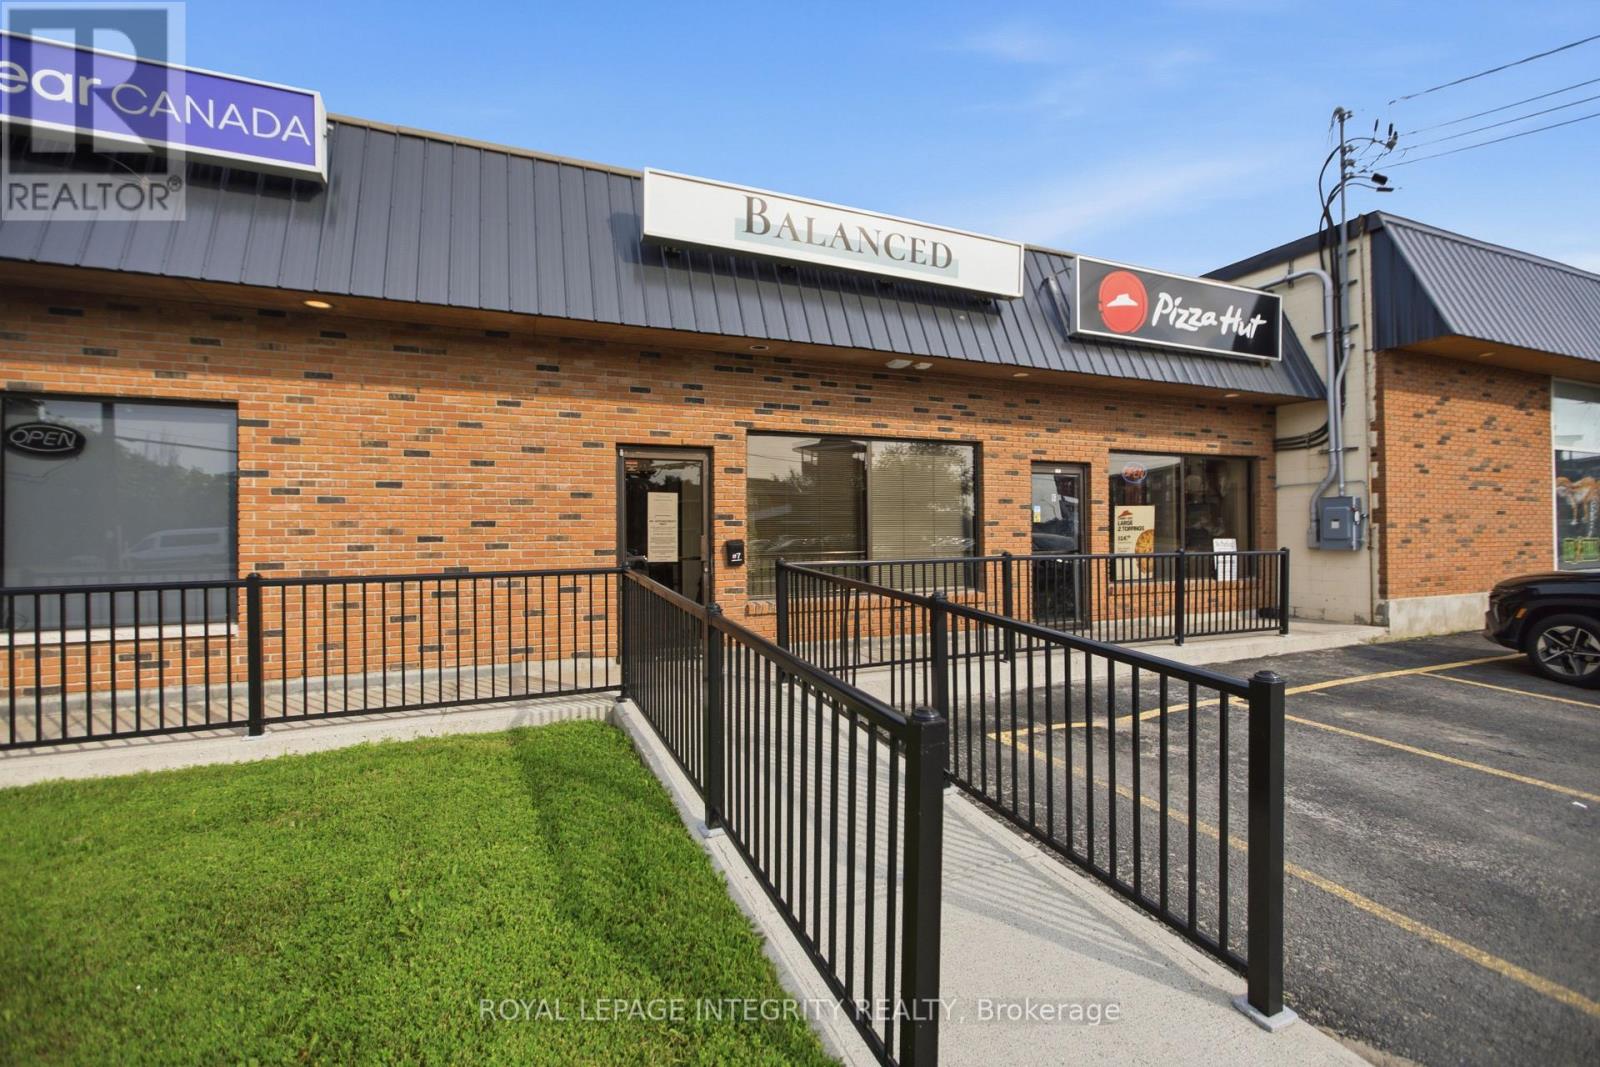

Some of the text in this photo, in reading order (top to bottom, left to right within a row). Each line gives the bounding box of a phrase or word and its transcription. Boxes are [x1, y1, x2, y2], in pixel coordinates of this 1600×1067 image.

[111, 83, 311, 147] CANADA
[743, 194, 954, 270] BALANCED
[1152, 291, 1267, 339] Pizza Hut
[9, 429, 77, 448] OPEN
